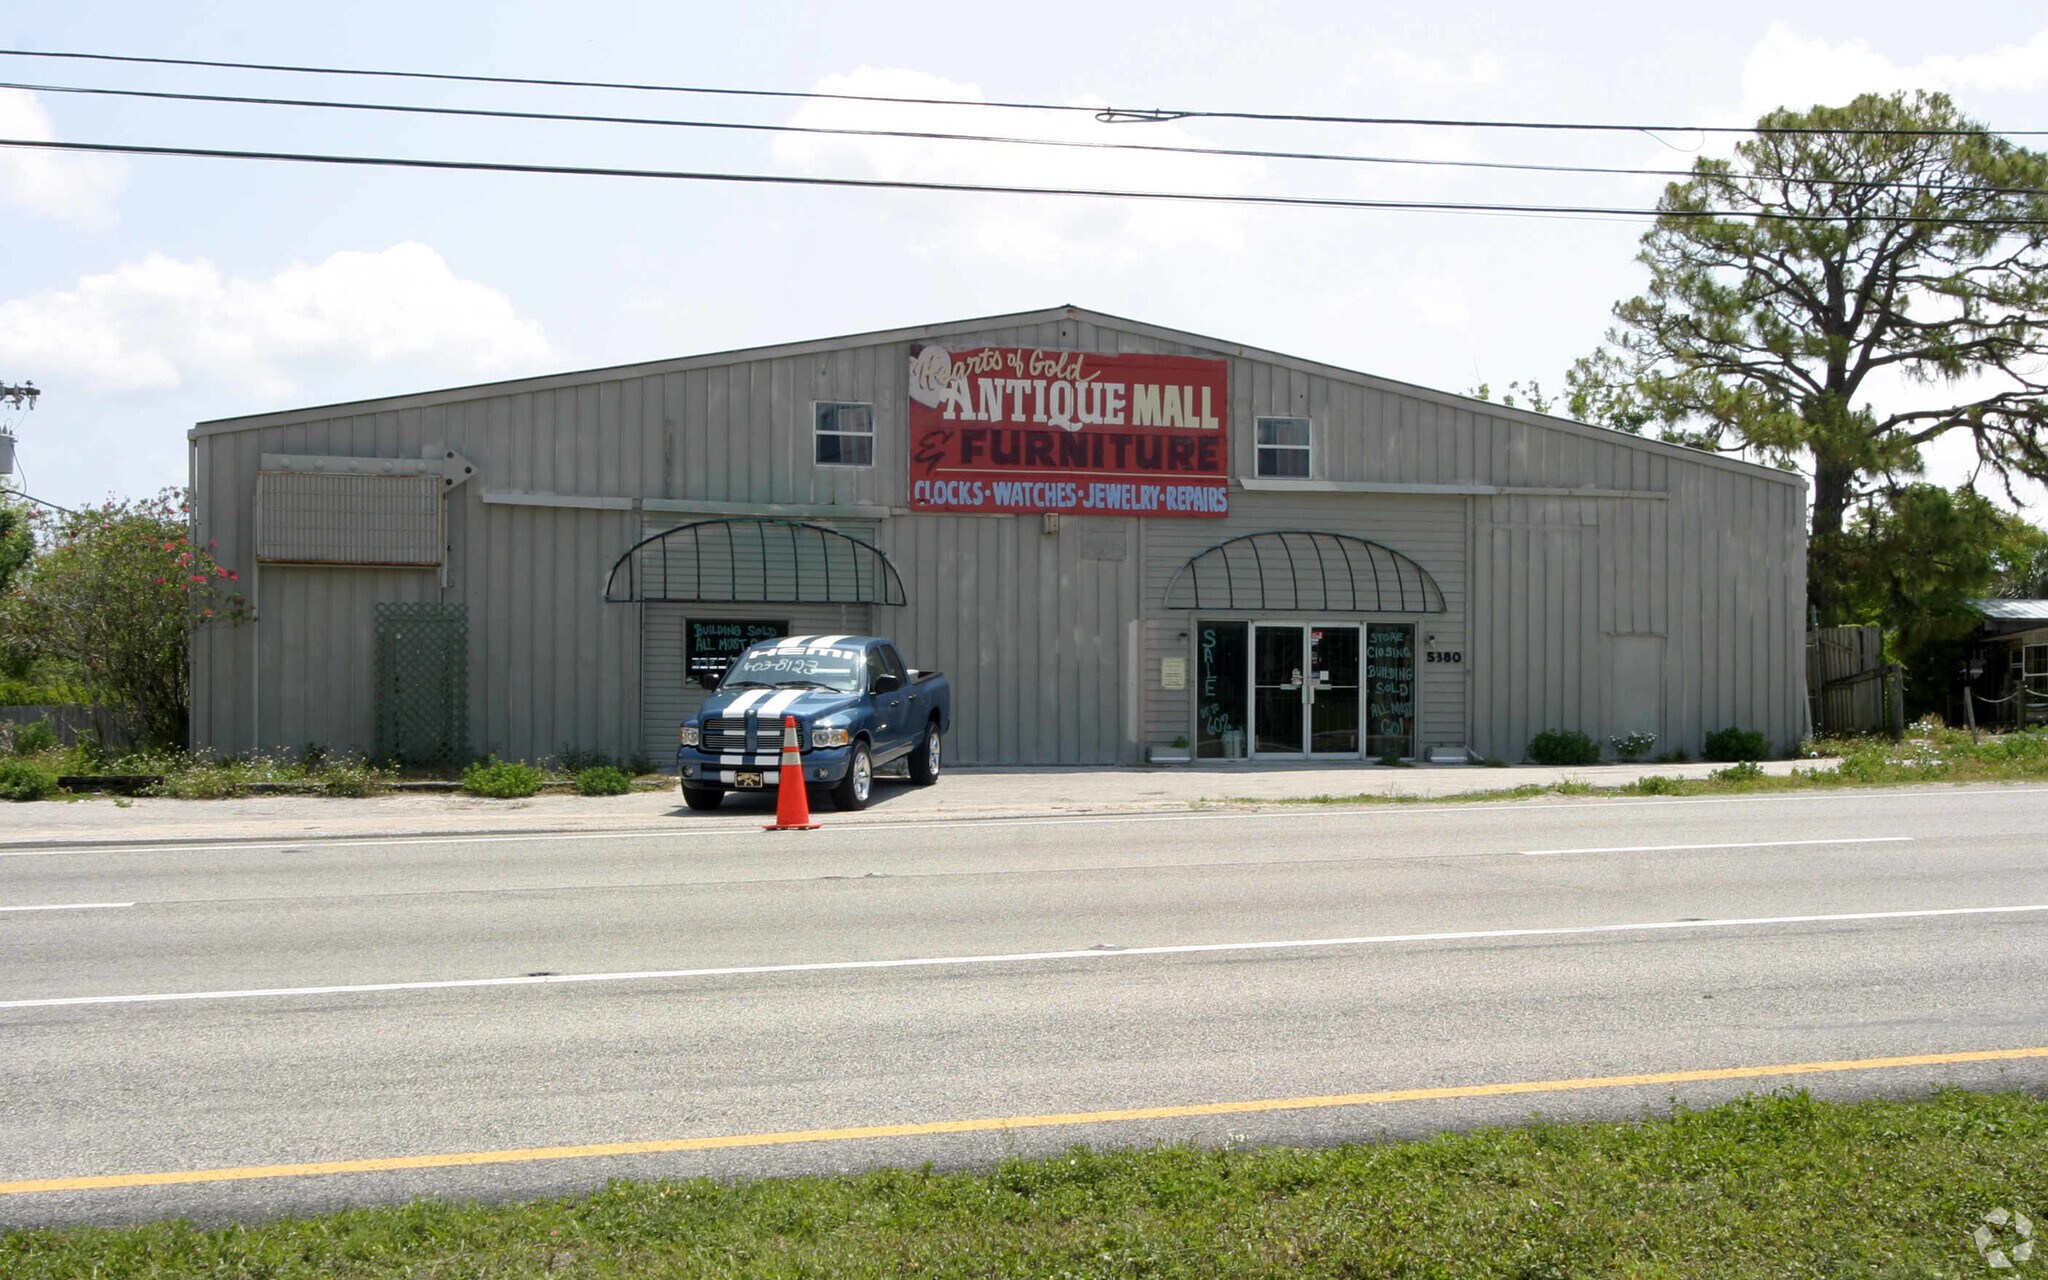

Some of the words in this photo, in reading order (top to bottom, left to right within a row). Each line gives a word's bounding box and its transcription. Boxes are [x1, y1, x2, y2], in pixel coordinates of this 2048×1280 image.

[913, 348, 1002, 391] Hearts
[1007, 349, 1024, 378] of
[1029, 349, 1101, 382] Gold
[943, 377, 1125, 432] ANTIQUE
[1132, 384, 1219, 429] MALL
[960, 429, 1219, 471] FURNITURE
[993, 482, 1076, 508] WATCHES
[1082, 484, 1160, 510] JEWELRY
[1166, 486, 1228, 512] REPAIRS
[694, 624, 742, 637] BUILDING
[747, 625, 777, 637] SOLD
[1369, 632, 1404, 643] STORE
[695, 639, 716, 651] ALL
[719, 638, 748, 650] MUST
[749, 647, 854, 660] HEMI
[1367, 647, 1412, 658] CLOSING
[1426, 651, 1462, 663] 5380
[1202, 629, 1218, 696] SALE
[1367, 665, 1413, 680] BUILDING
[1375, 682, 1408, 696] SOLD
[1371, 703, 1390, 717] ALL
